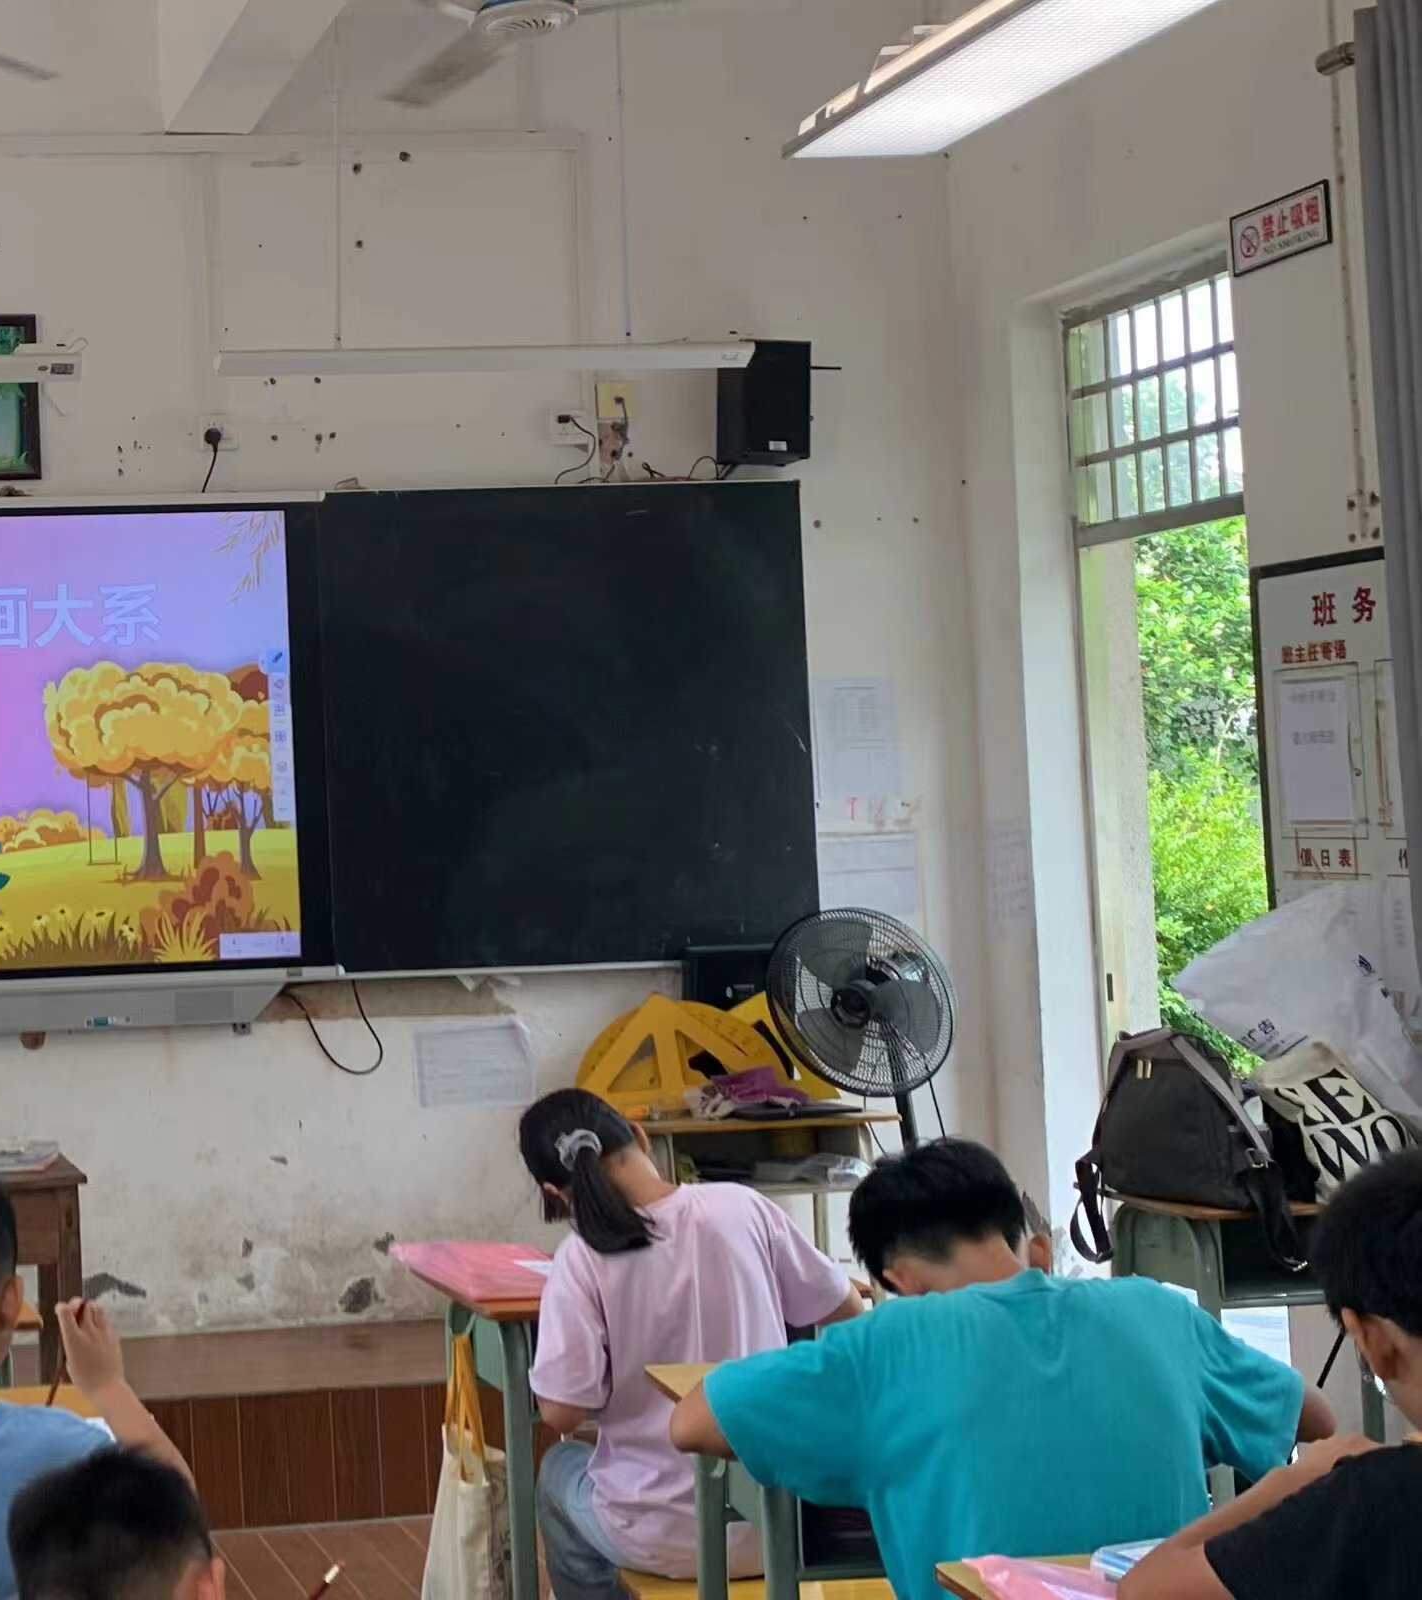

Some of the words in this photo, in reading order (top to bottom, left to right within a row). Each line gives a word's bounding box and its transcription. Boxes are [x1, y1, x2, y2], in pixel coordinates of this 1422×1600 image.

[1262, 196, 1320, 242] 禁止吸烟
[1300, 847, 1352, 868] 值日表
